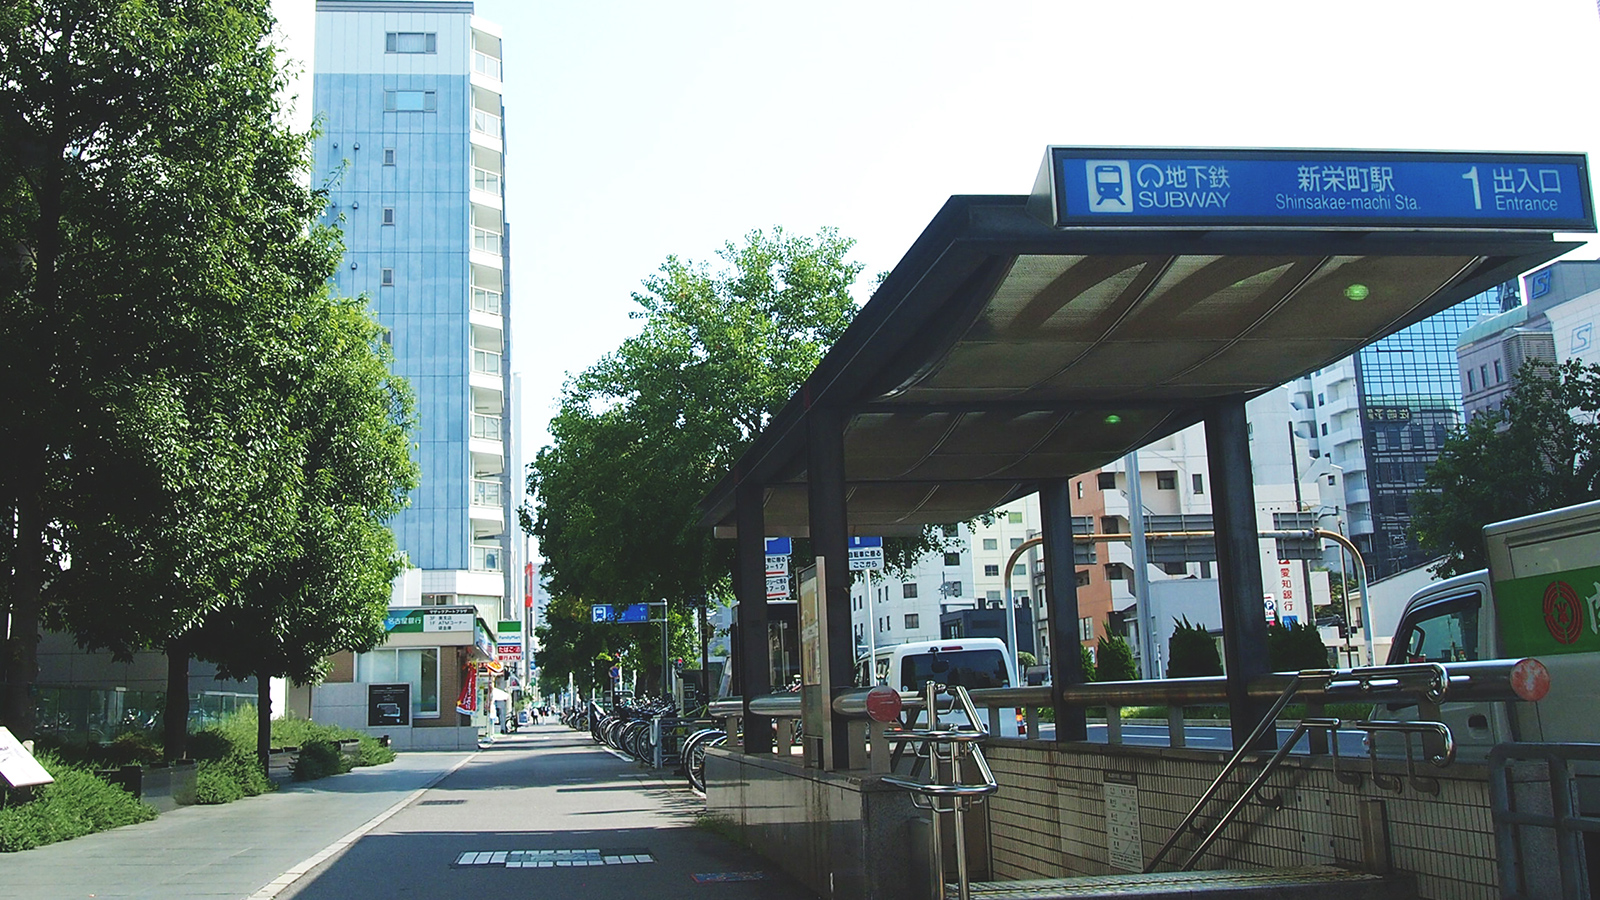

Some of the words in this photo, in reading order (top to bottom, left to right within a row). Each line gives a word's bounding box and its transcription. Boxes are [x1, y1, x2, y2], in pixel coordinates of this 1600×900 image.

[1165, 165, 1230, 189] 地下鉄
[1297, 165, 1395, 192] 新栄町駅
[1462, 166, 1482, 210] 1
[1492, 167, 1561, 193] 出入口
[1138, 191, 1231, 208] SUBWAY
[1275, 193, 1391, 210] Shinsakae-machi
[1394, 194, 1421, 210] Sta.
[1495, 195, 1558, 211] Entrance
[1280, 568, 1293, 611] 愛知銀行
